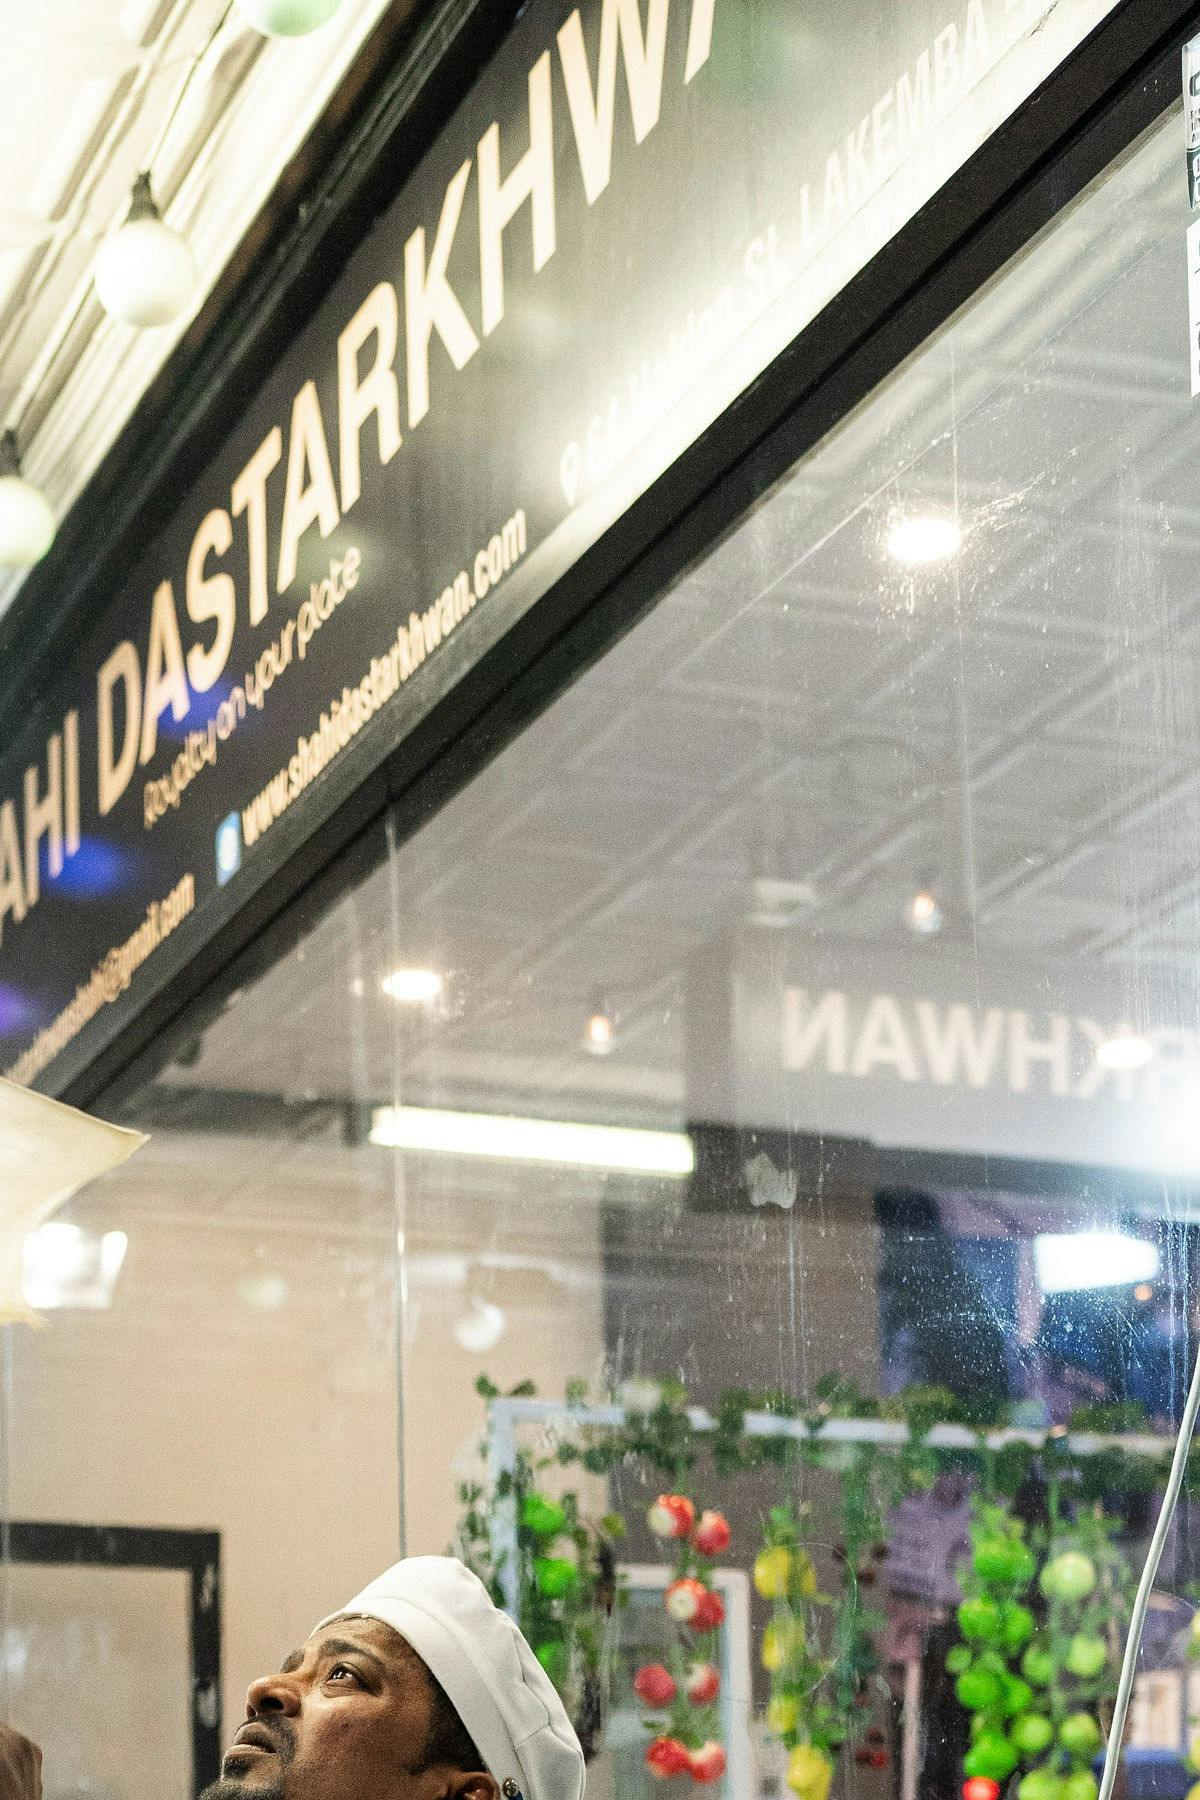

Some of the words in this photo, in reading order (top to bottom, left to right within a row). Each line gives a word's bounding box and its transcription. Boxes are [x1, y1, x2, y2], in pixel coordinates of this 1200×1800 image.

[800, 0, 990, 252] LAKEMBA
[97, 0, 714, 816] DASTARKHW
[245, 619, 296, 710] your
[297, 546, 362, 659] place
